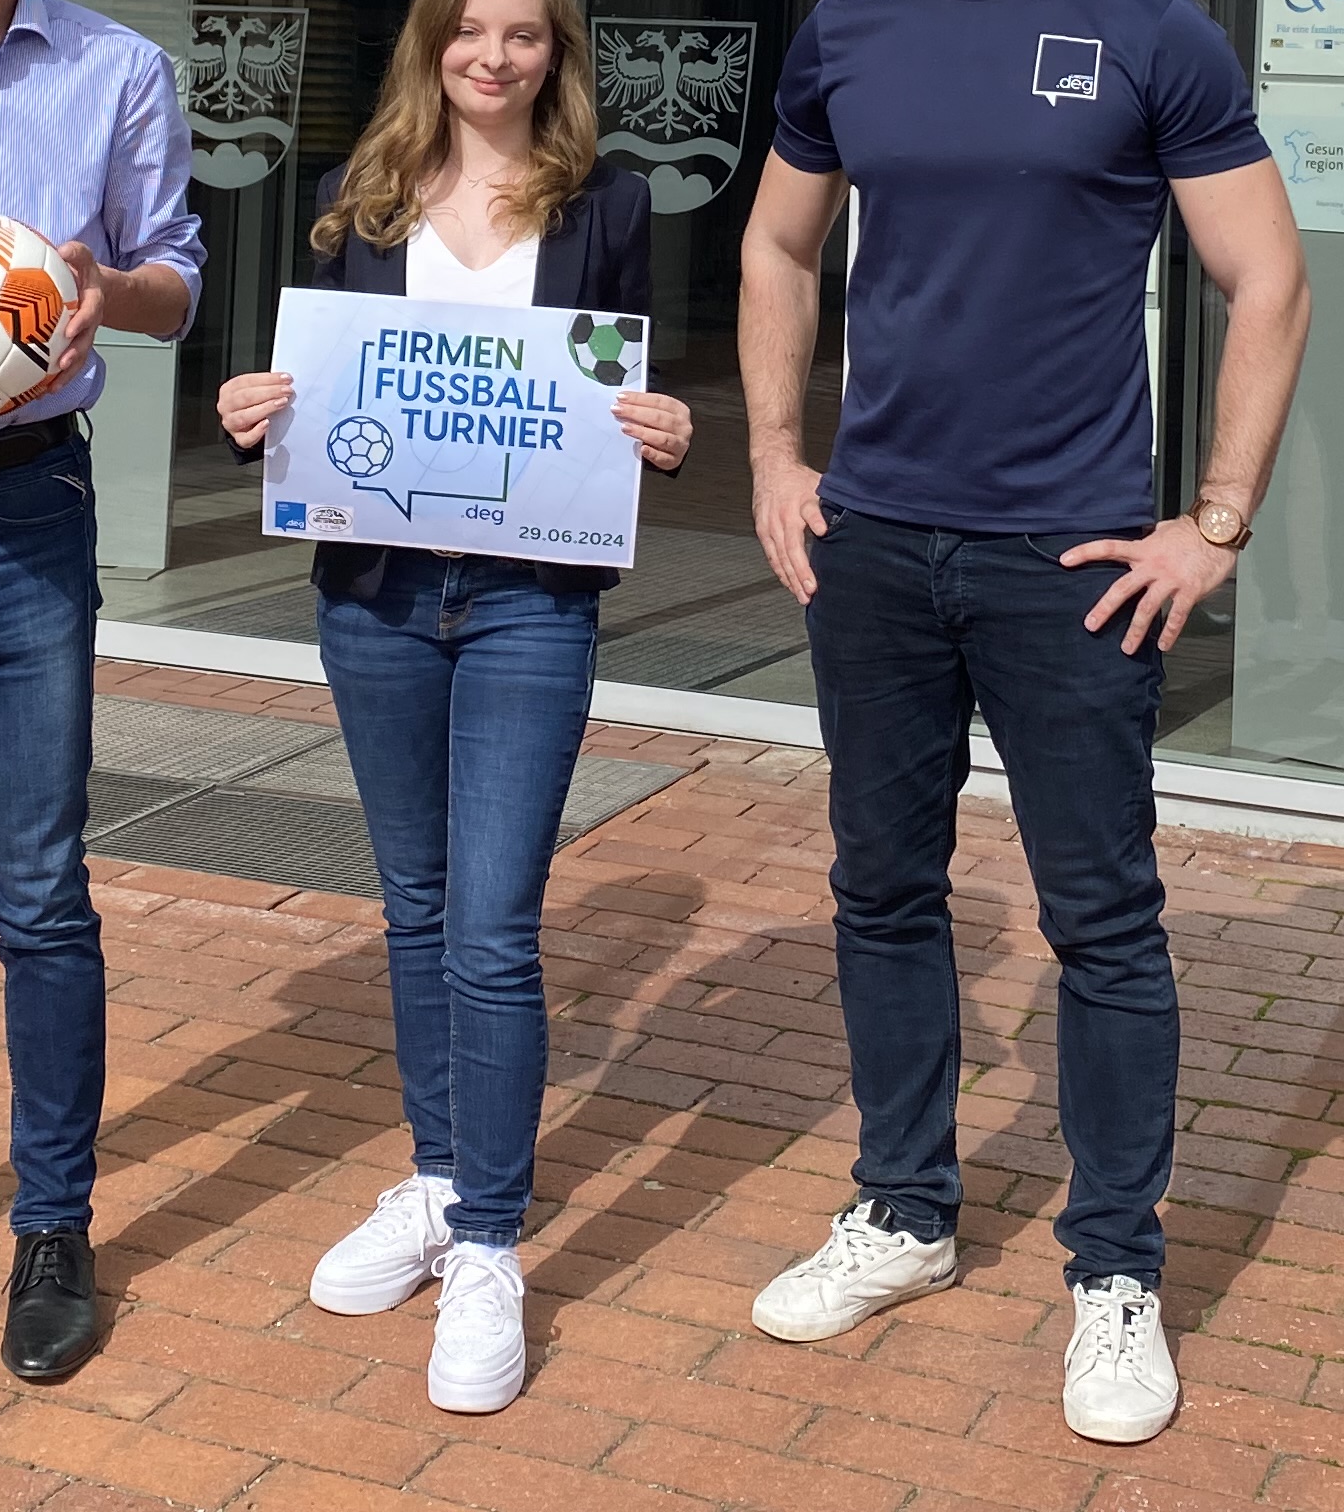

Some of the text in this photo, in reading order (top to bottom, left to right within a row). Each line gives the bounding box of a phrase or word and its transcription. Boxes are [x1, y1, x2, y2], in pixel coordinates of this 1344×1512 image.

[377, 328, 524, 371] FIRMEN
[375, 367, 567, 413] FUSSBALL
[401, 408, 563, 450] TURNIER
[518, 526, 625, 547] 29.06.2024
